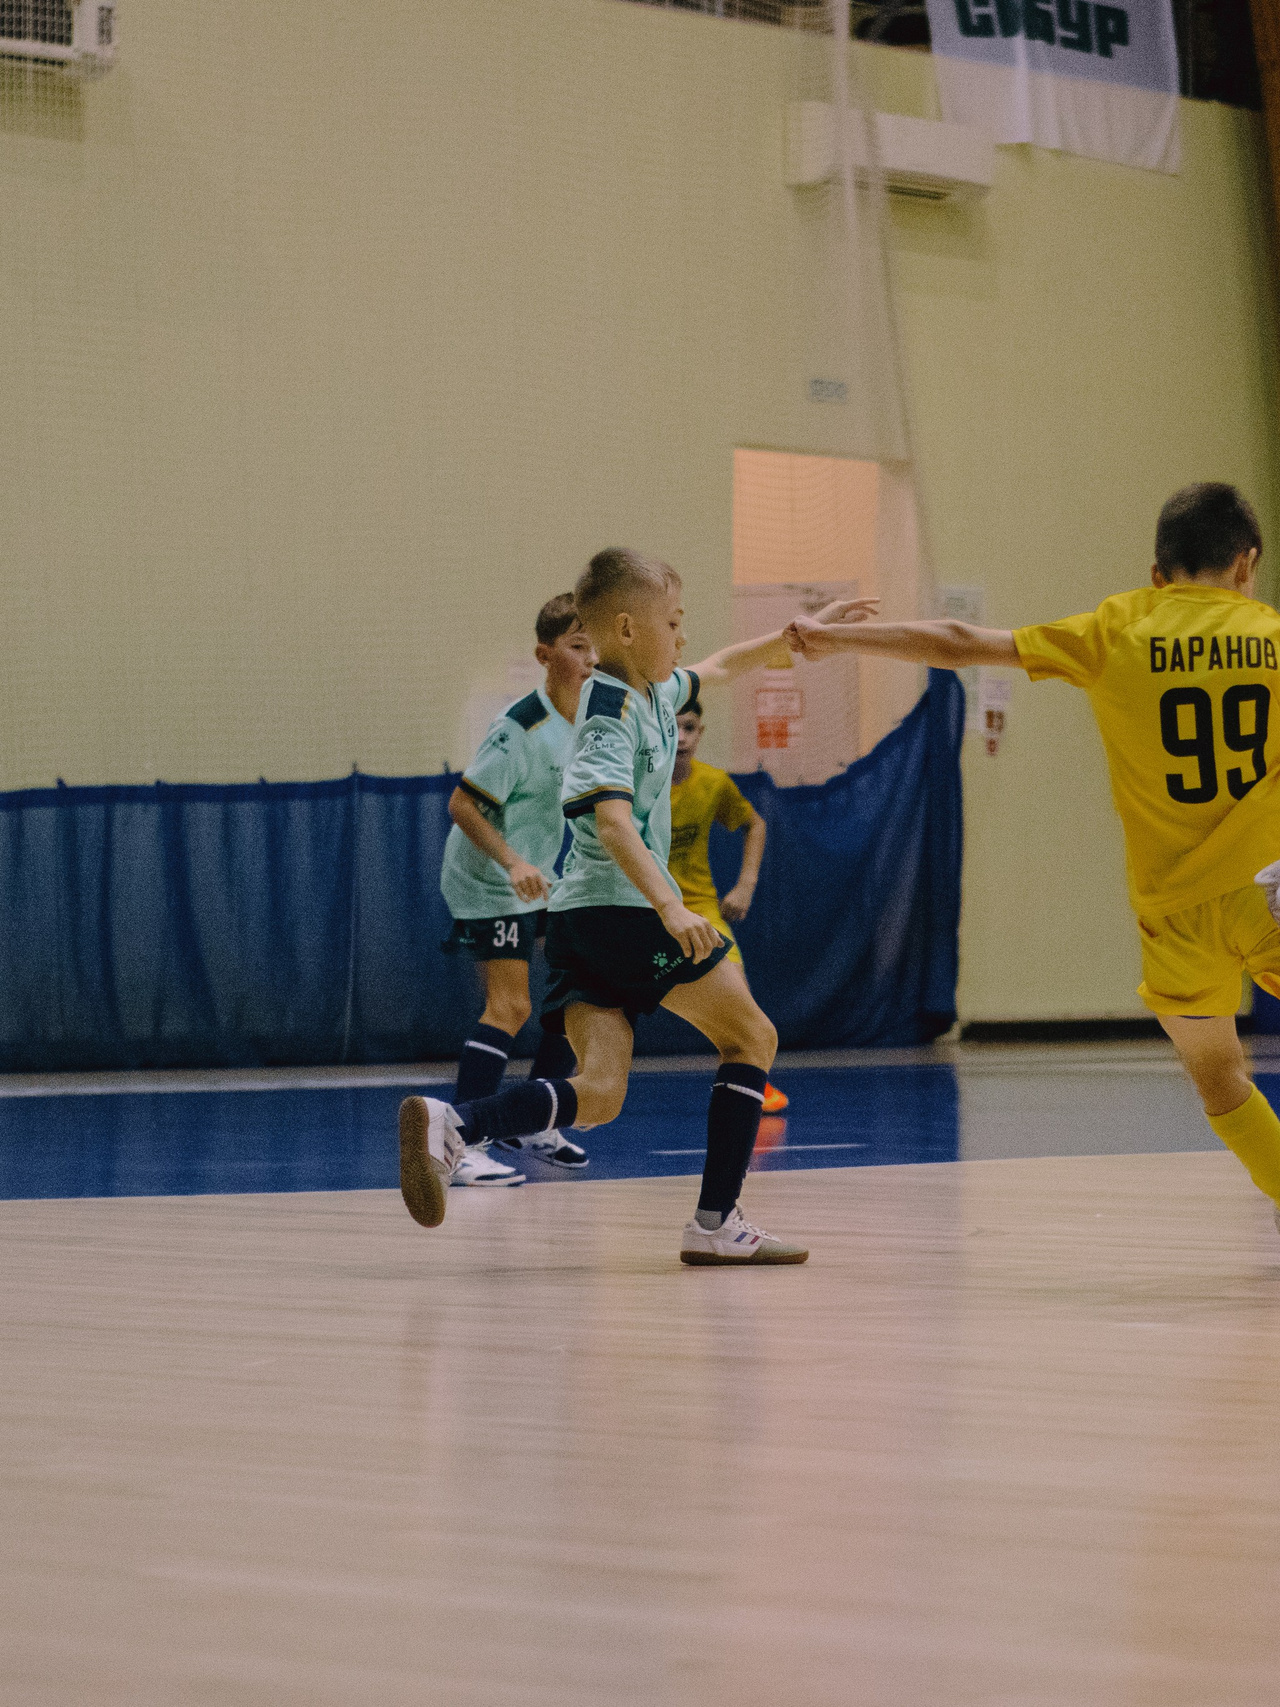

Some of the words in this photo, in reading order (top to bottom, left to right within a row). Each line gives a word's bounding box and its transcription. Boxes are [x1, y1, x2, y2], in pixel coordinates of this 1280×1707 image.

[1150, 636, 1278, 673] БАРАНОВ
[1159, 684, 1271, 804] 99
[493, 920, 520, 948] 34
[653, 956, 684, 981] KELME
